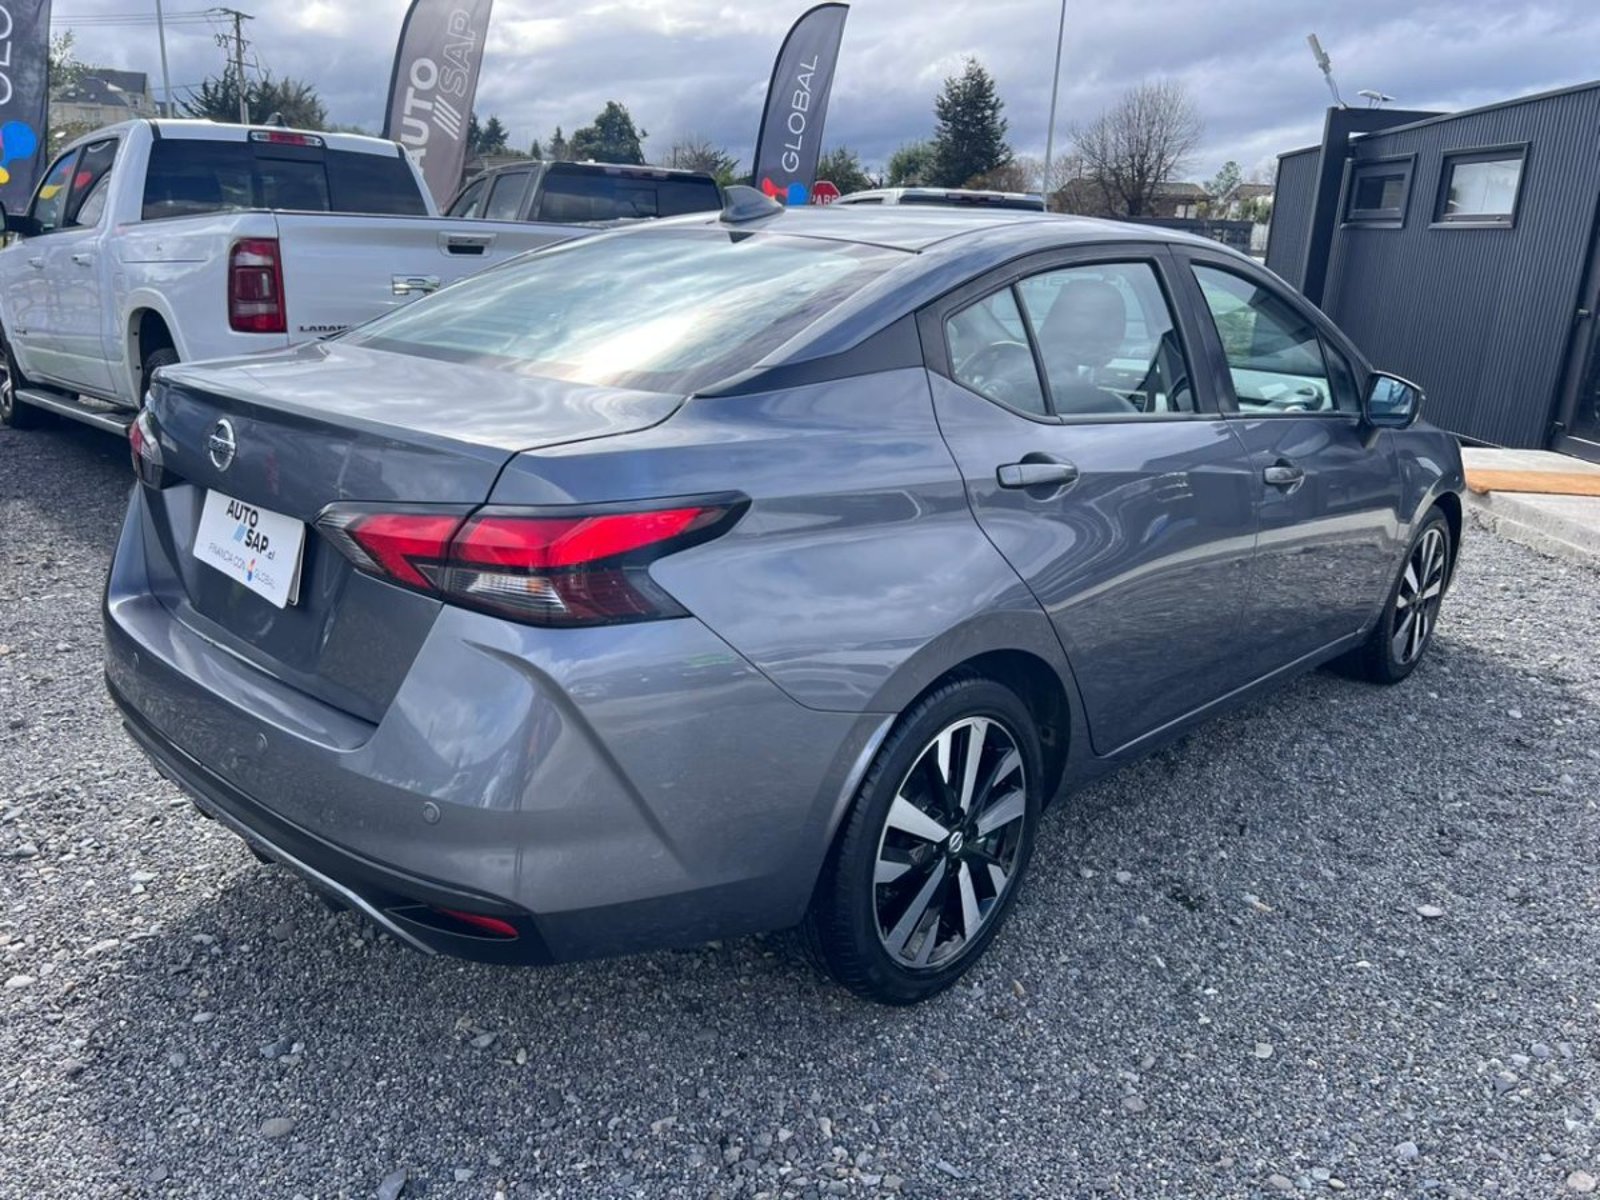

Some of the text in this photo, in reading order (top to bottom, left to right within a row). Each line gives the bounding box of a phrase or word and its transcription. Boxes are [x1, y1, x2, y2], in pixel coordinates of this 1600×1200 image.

[438, 8, 477, 97] SAP
[400, 57, 438, 177] AUTO
[781, 54, 819, 173] GLOBAL
[225, 499, 259, 529] AUTO
